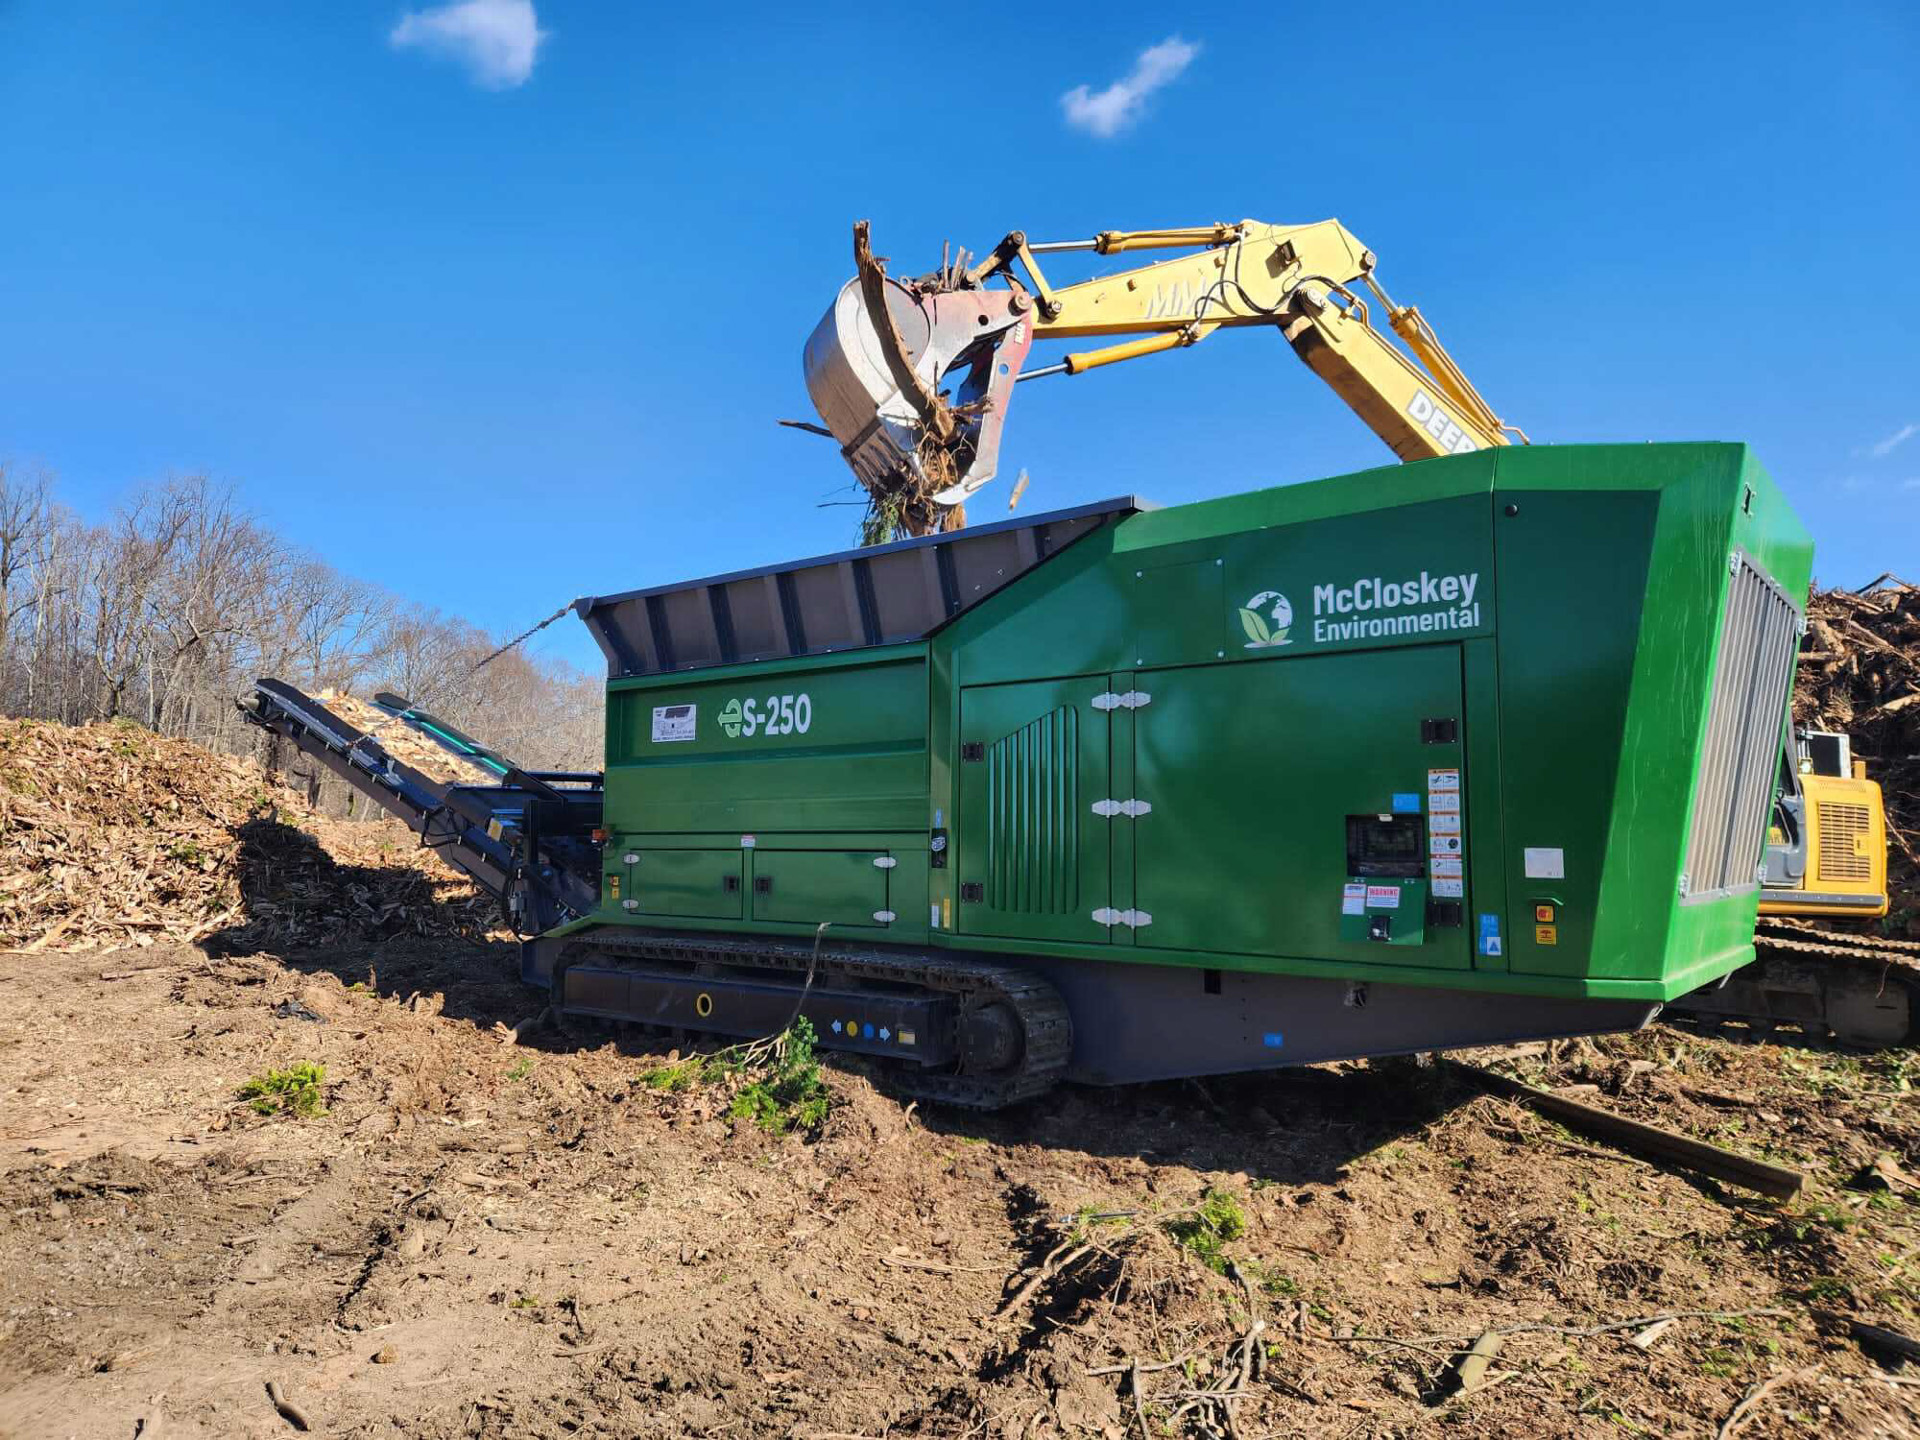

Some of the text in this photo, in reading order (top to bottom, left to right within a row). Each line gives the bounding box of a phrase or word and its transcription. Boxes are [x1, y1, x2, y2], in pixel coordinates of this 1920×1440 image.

[1406, 388, 1478, 453] DEER
[1313, 571, 1478, 615] McCloskey
[1314, 602, 1480, 642] Environmental
[742, 693, 812, 737] S-250
